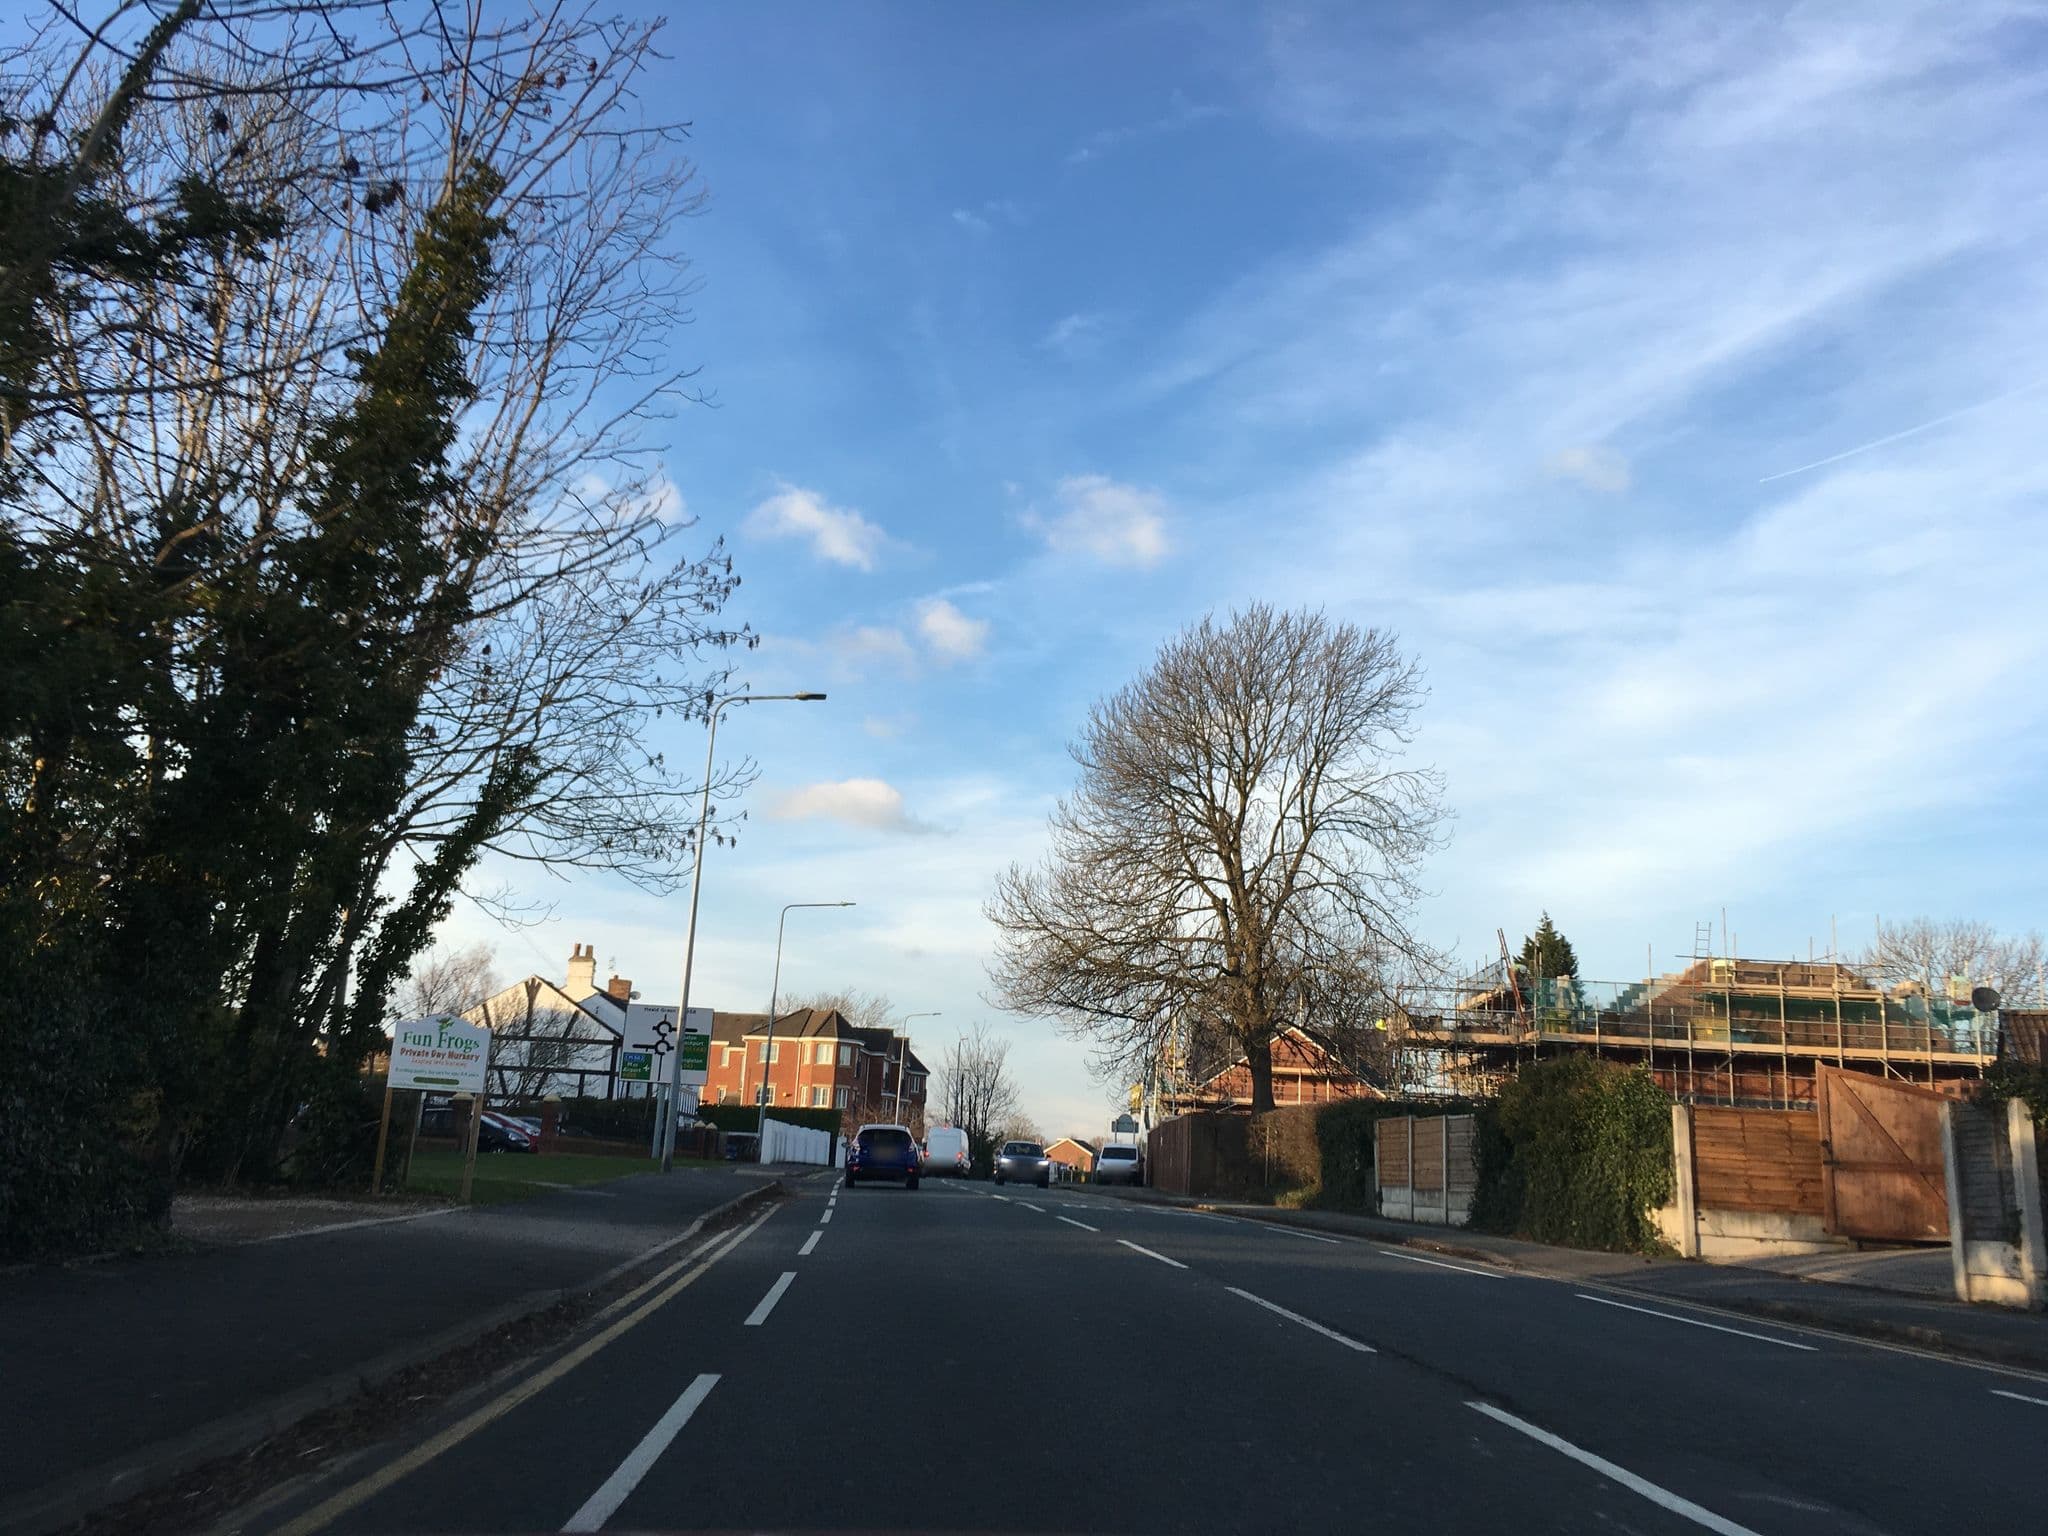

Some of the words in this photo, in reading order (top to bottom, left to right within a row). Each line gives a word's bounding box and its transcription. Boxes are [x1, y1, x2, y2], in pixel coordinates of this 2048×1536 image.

[403, 1031, 432, 1046] Fun
[437, 1031, 480, 1052] Frogs
[400, 1047, 429, 1058] Private
[431, 1049, 446, 1060] Day
[448, 1051, 480, 1062] Nursery
